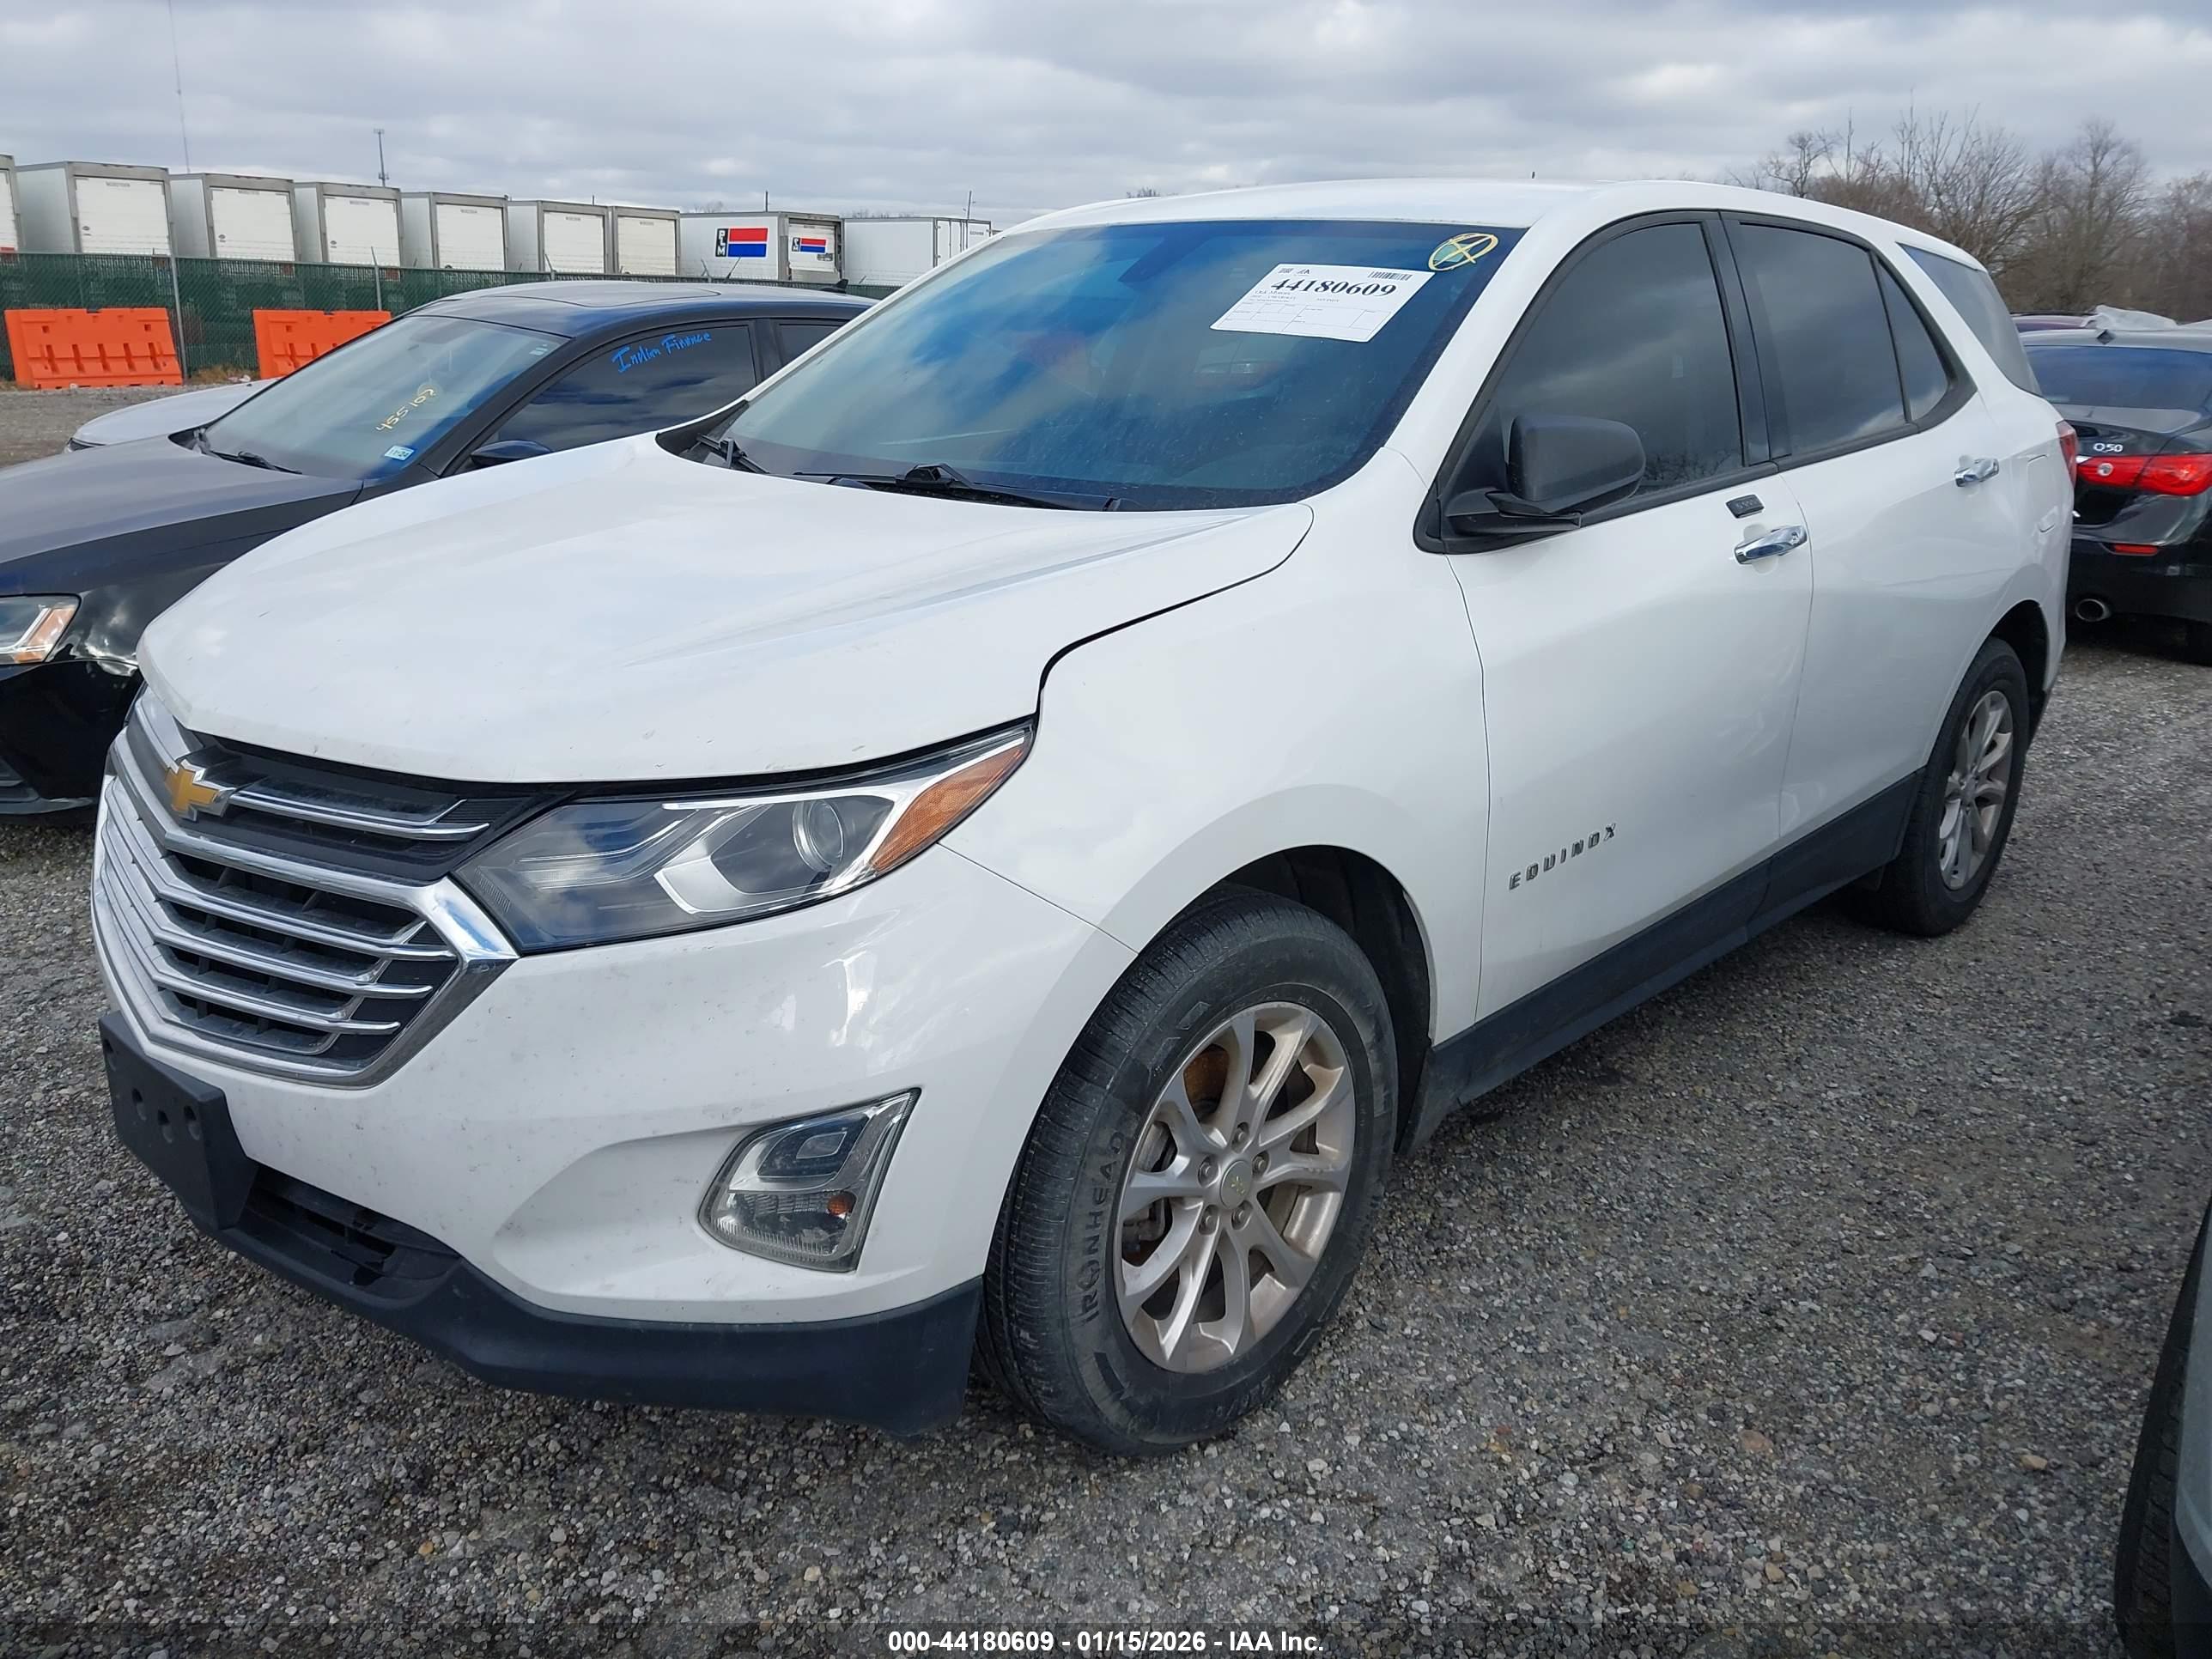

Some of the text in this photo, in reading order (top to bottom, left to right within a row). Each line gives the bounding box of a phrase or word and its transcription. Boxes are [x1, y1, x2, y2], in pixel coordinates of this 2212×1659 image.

[718, 229, 726, 256] PLM
[1270, 278, 1397, 297] 44180609
[2094, 442, 2124, 453] Q50
[1509, 823, 1616, 890] EQUINOX
[1076, 1131, 1125, 1326] IRONHEAD
